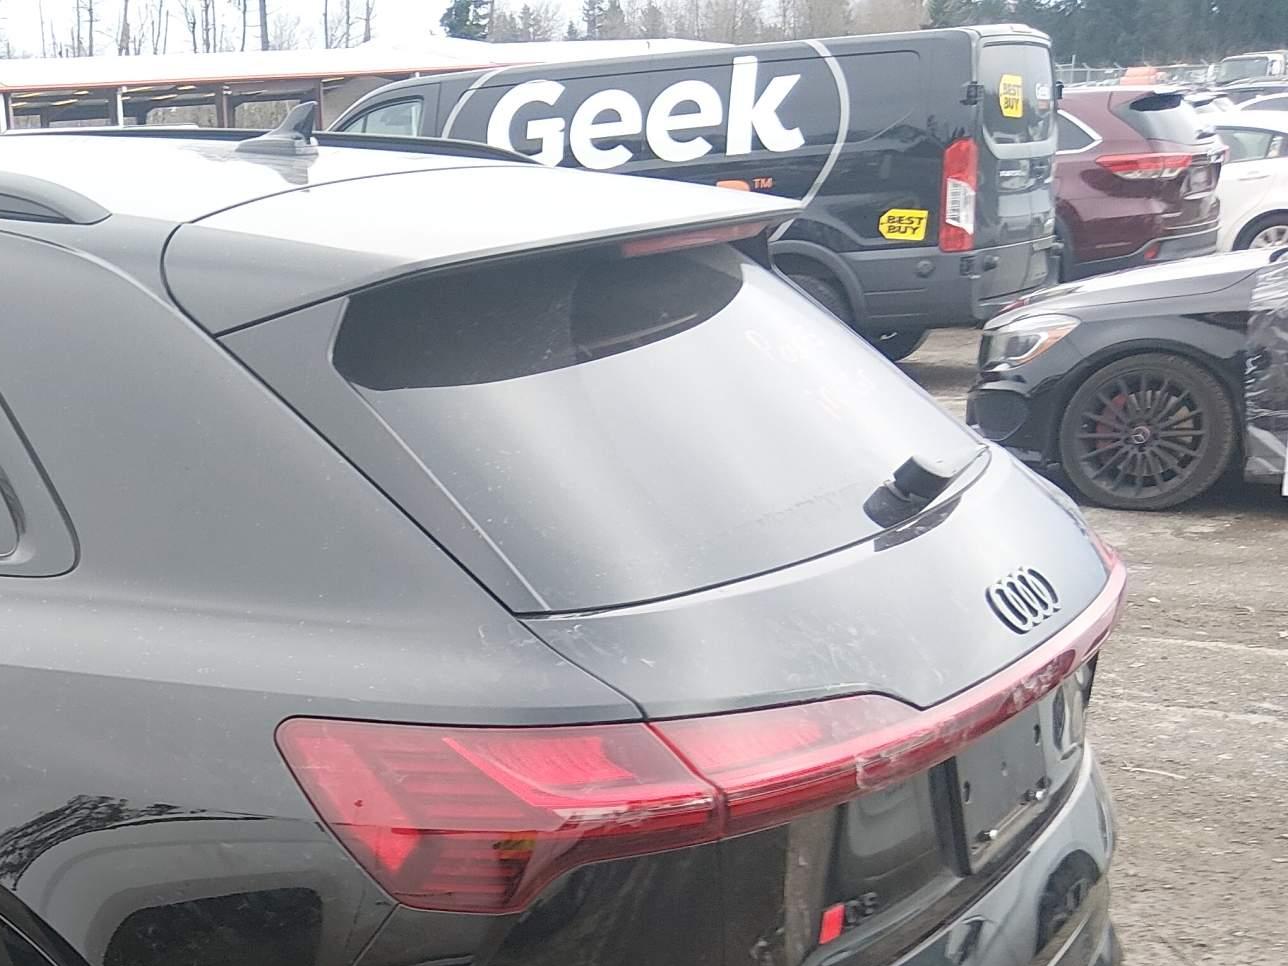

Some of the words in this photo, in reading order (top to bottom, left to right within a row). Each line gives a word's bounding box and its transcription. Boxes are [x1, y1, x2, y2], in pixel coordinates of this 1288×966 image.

[487, 55, 805, 170] Geek
[887, 215, 924, 226] BEST
[887, 225, 921, 235] BUY
